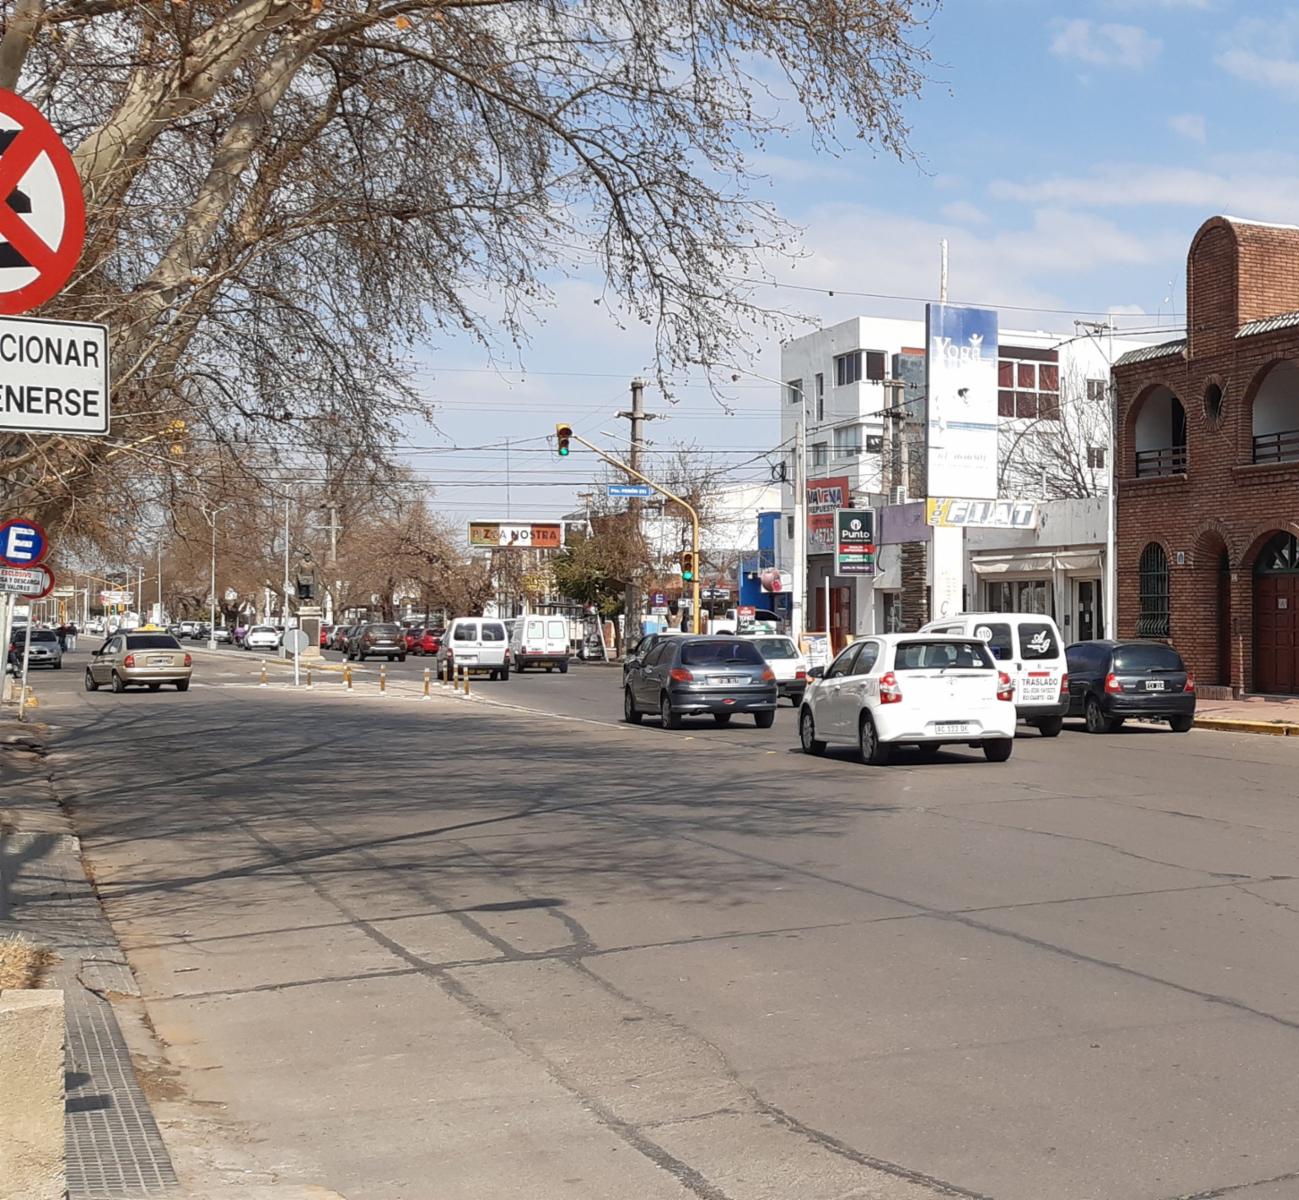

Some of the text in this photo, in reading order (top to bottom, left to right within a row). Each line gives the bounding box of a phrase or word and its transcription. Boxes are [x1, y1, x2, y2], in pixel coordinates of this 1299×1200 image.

[0, 333, 99, 368] CIONAR
[0, 384, 99, 417] NERSE
[945, 501, 1033, 527] FIAT
[6, 526, 35, 560] E
[511, 529, 558, 540] NOSTRA
[842, 530, 870, 539] Punto
[1021, 678, 1058, 686] TRASLADO
